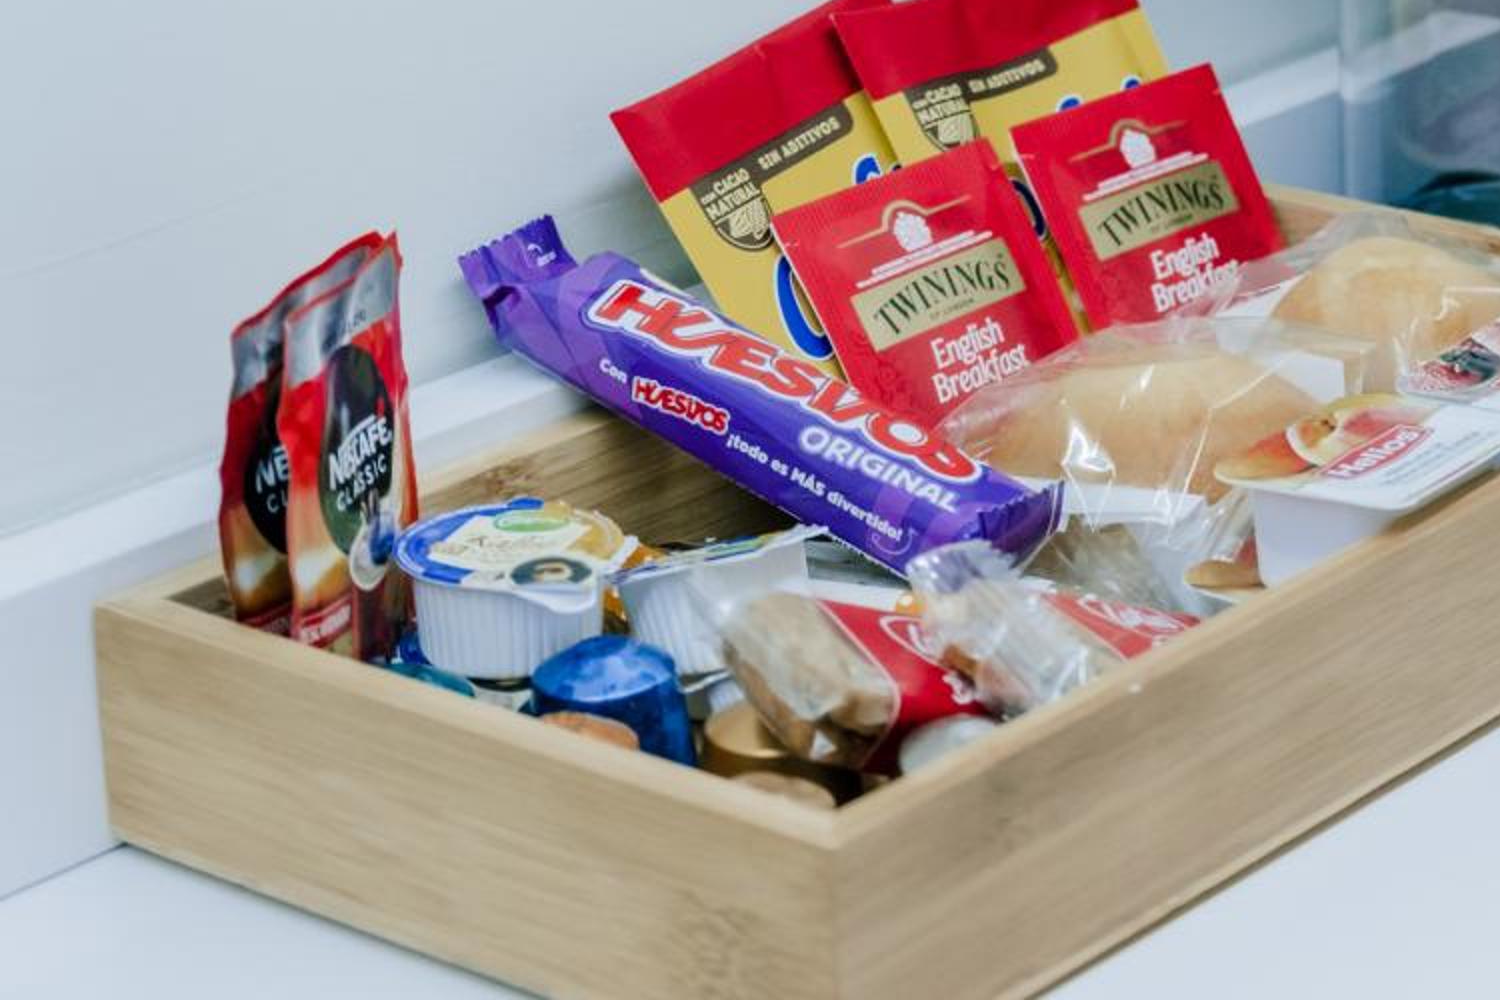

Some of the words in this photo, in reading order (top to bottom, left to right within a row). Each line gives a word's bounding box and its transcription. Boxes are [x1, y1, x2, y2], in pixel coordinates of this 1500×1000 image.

[757, 149, 783, 170] SIN
[780, 116, 841, 159] ADITIVOS
[705, 181, 761, 221] NATURAL
[712, 167, 750, 195] CACAO
[1096, 179, 1225, 247] TWININGS
[1150, 231, 1220, 280] English
[872, 258, 1012, 335] TWININGS
[929, 316, 1005, 370] English
[931, 343, 1029, 404] Breakfast
[599, 357, 627, 383] Con
[633, 376, 731, 434] HUESVOS
[726, 433, 769, 465] ¡todo
[770, 458, 790, 477] es
[790, 466, 826, 497] MÁS
[826, 489, 903, 542] divertido!
[800, 425, 958, 513] ORIGINAL
[336, 453, 388, 512] CLASSIC
